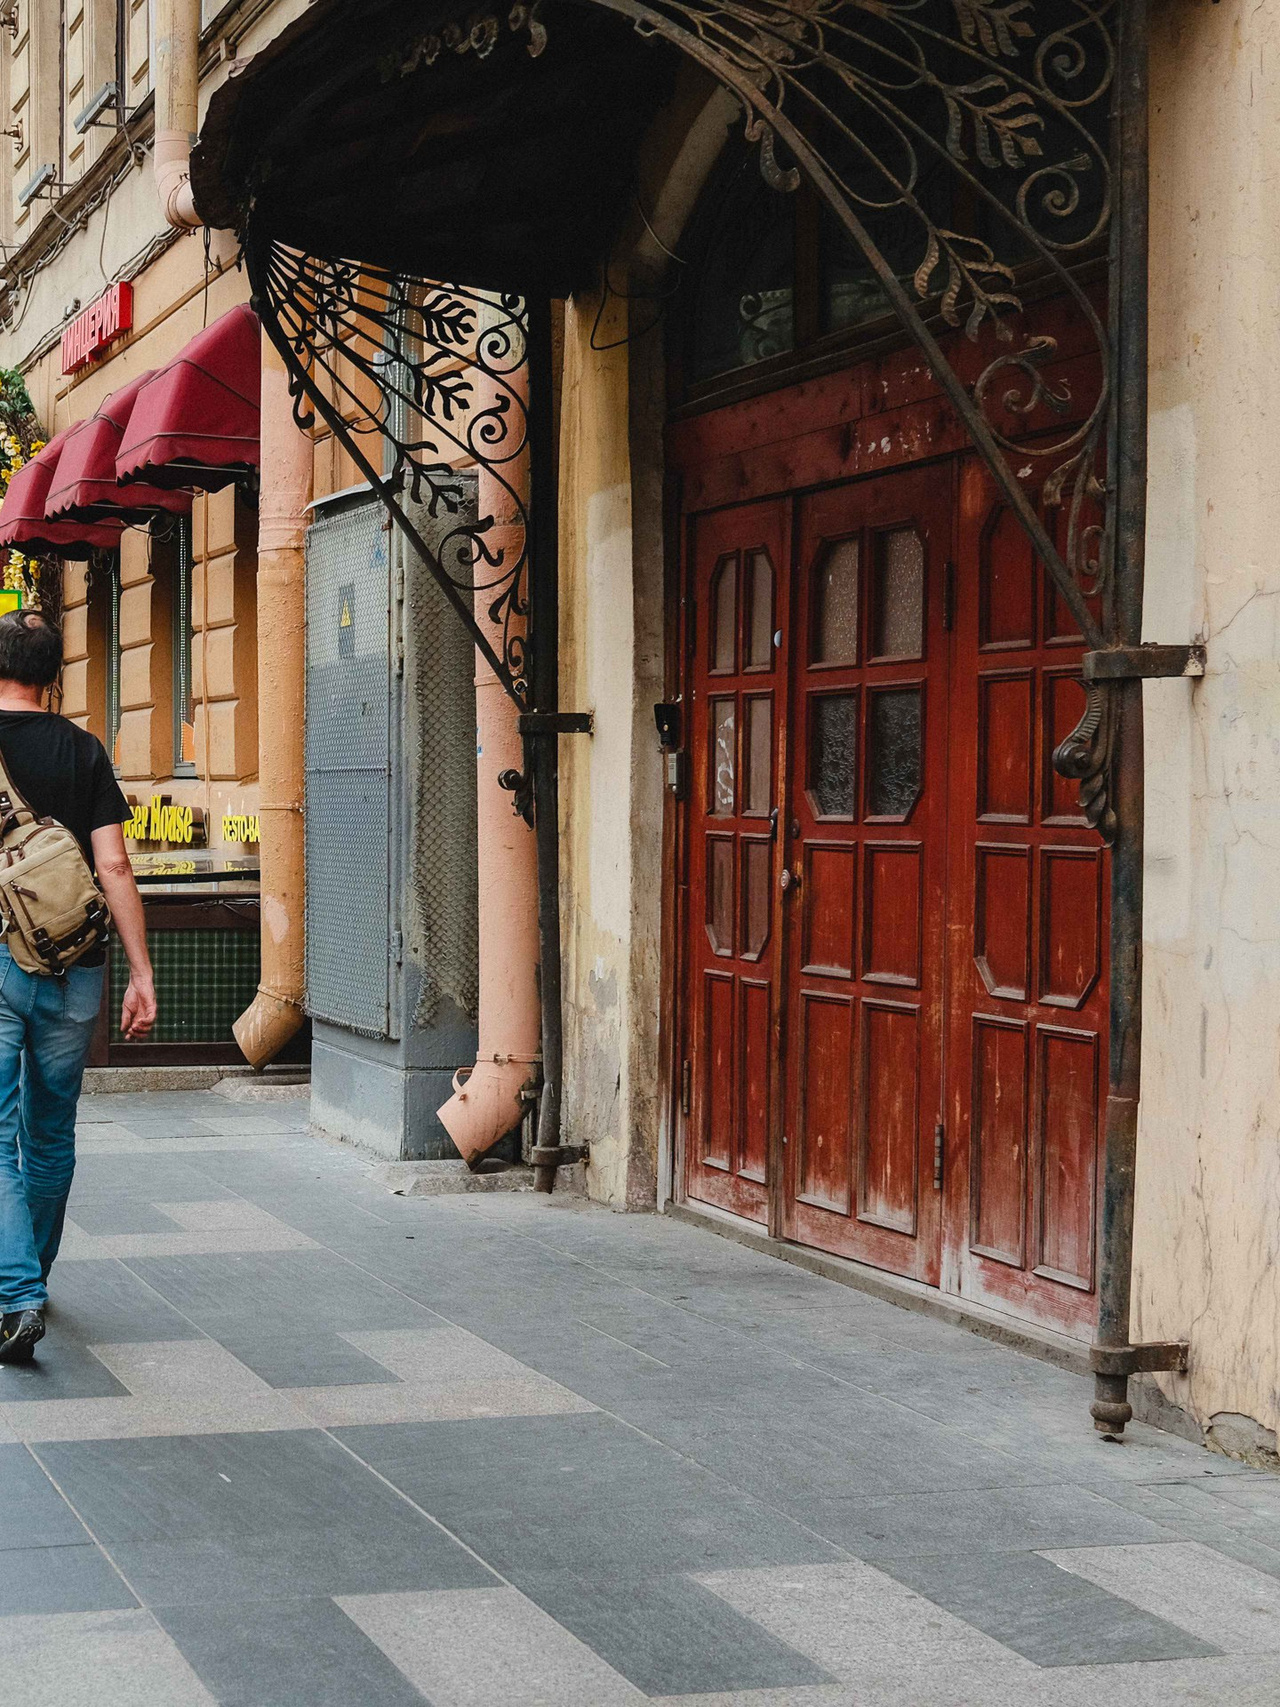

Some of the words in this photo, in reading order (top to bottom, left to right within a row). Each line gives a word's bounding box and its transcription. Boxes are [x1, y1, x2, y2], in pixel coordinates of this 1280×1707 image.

[61, 281, 120, 375] ПИНЦЕРИЯ
[150, 794, 193, 843] House
[222, 816, 260, 843] RESTO-BA
